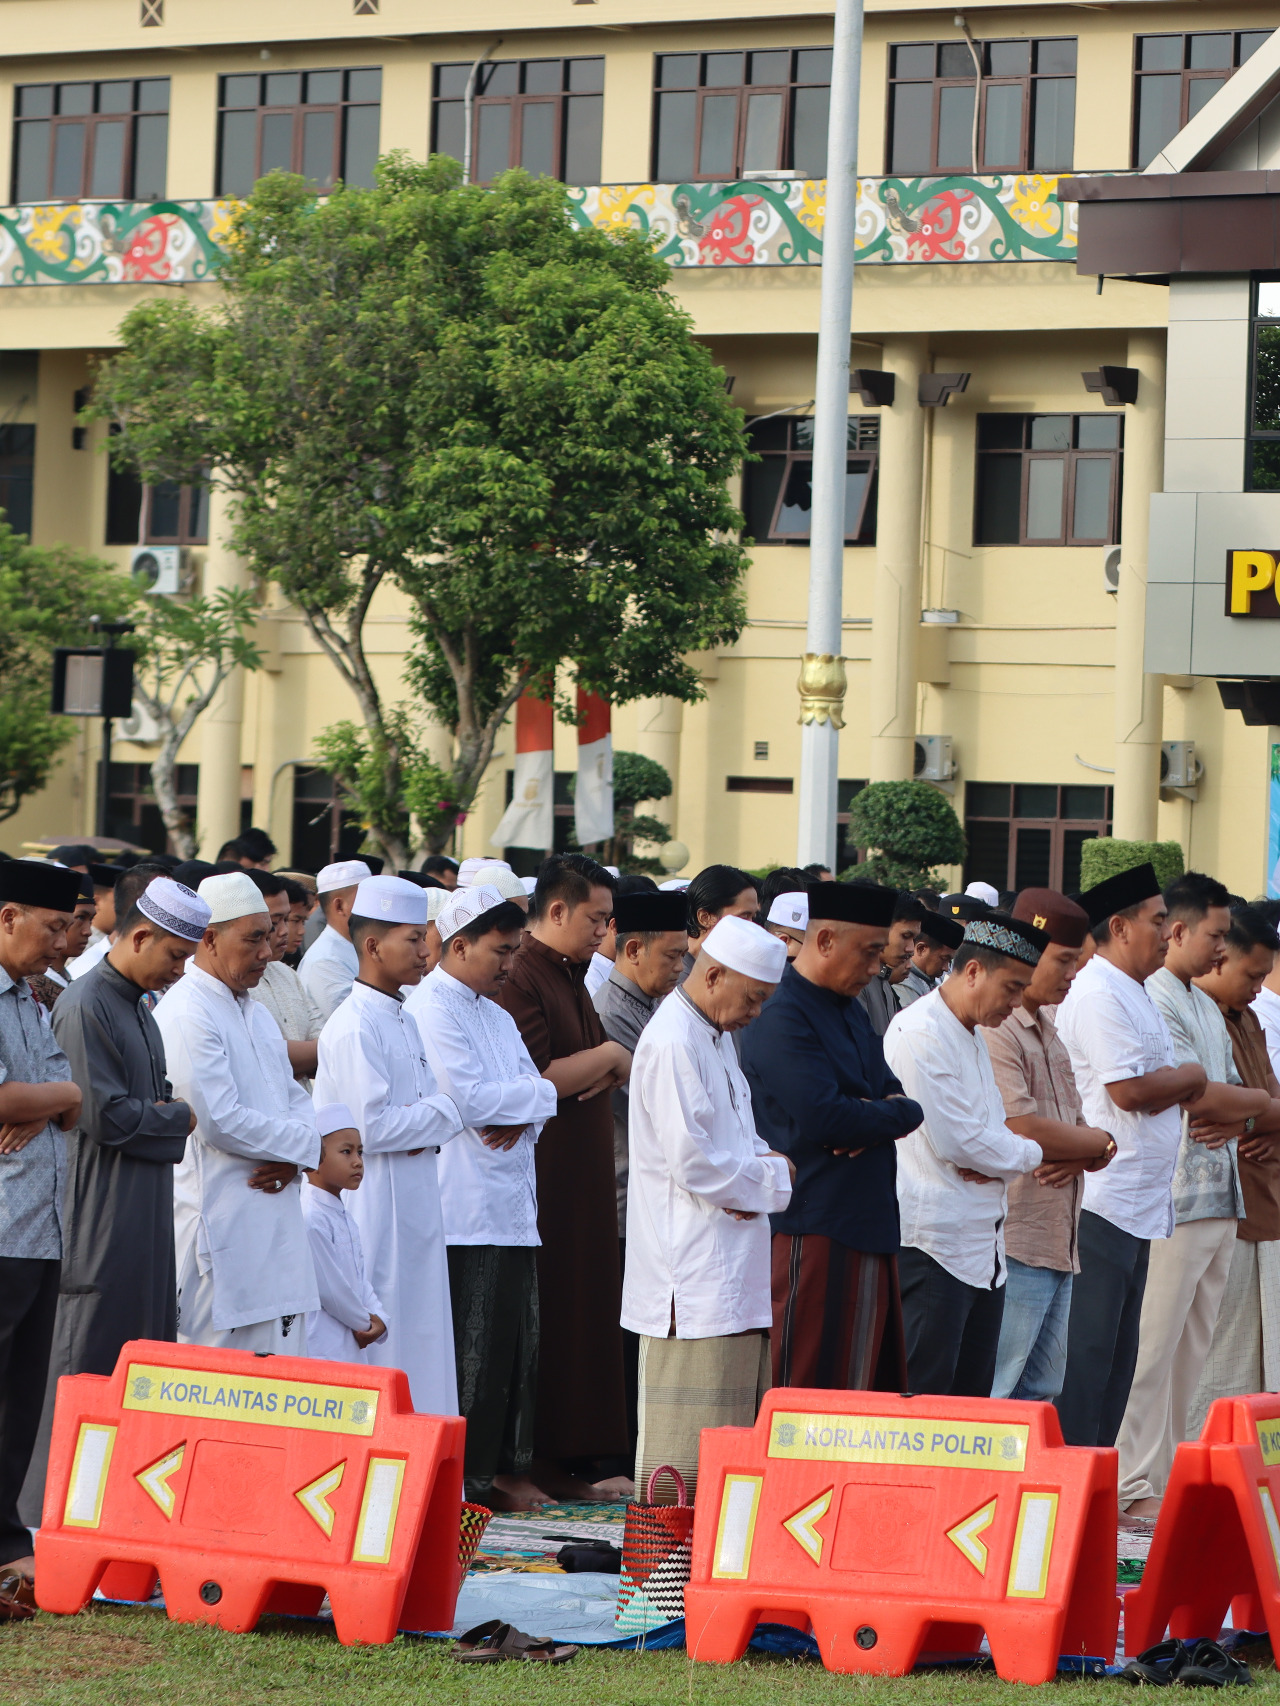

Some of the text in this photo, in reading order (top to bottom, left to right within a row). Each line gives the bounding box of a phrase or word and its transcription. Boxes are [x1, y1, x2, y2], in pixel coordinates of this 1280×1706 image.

[160, 1381, 343, 1420] KORLANTAS POLRI
[805, 1426, 992, 1456] KORLANTAS POLRI
